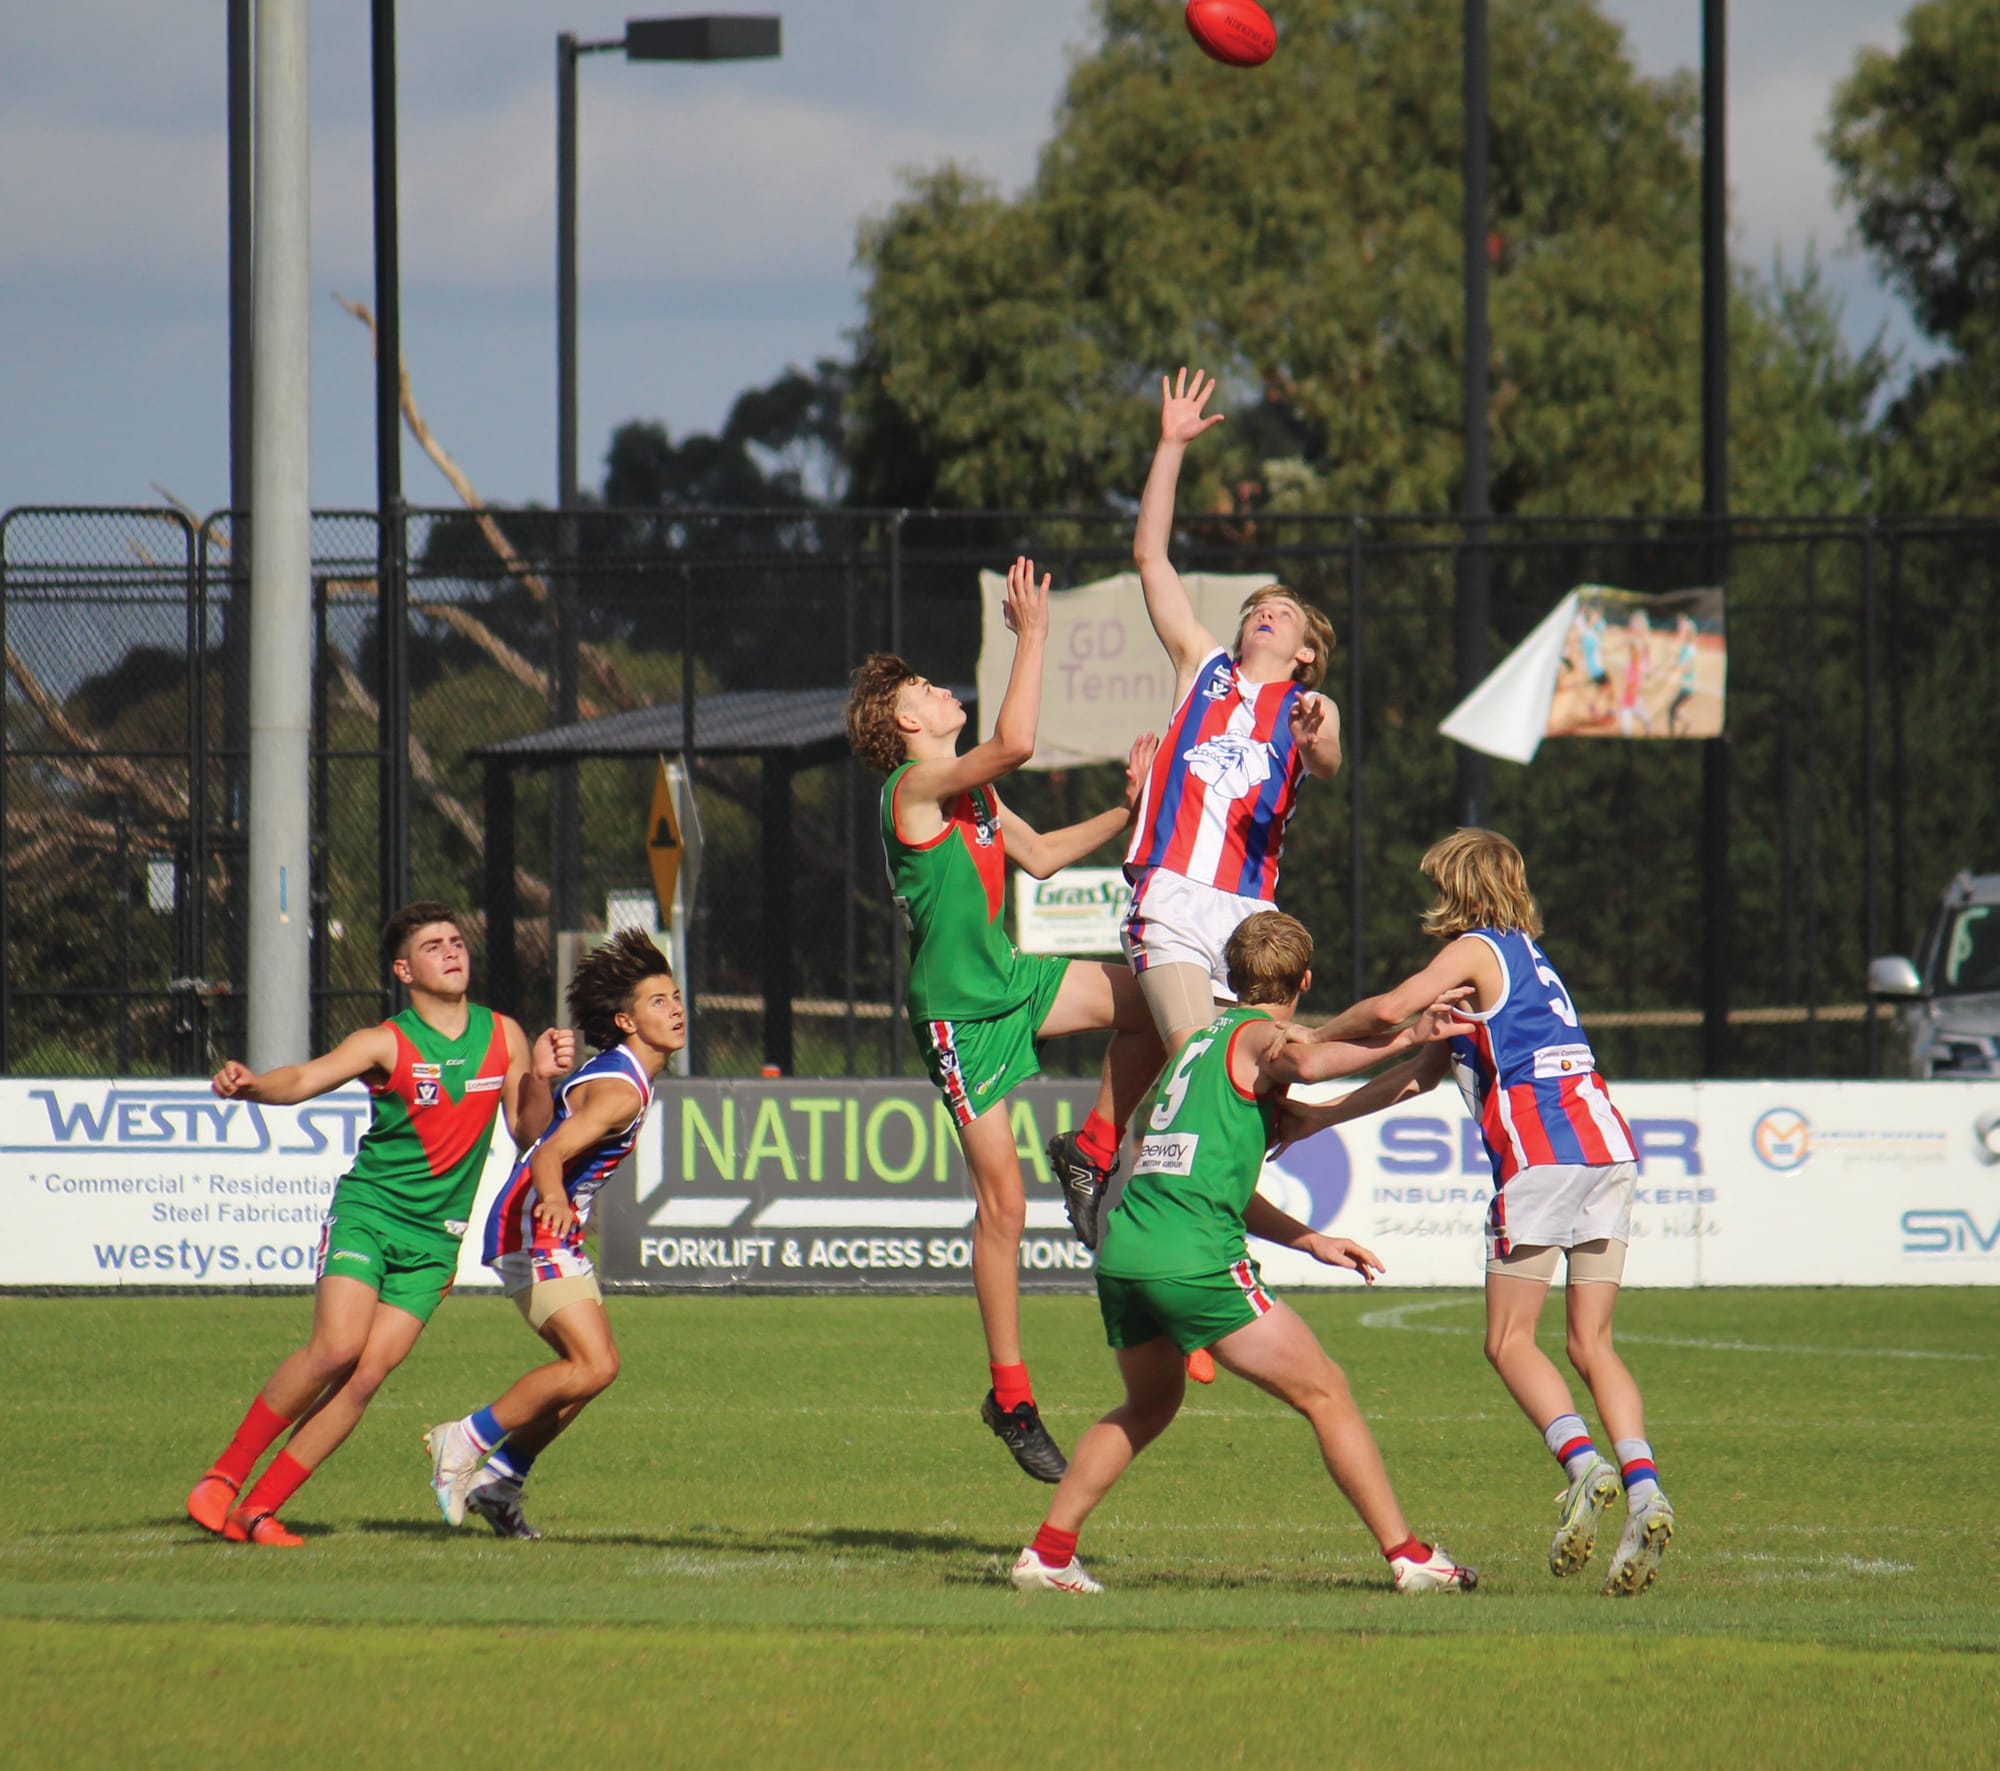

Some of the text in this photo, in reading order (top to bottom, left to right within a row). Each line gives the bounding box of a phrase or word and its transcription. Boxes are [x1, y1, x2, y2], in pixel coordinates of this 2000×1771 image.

[1068, 619, 1126, 660] GD
[1150, 1038, 1215, 1131] 5
[45, 1173, 184, 1194] Commercial
[1374, 1188, 1716, 1204] INSURA KERS
[152, 1203, 210, 1222] Steel
[640, 1238, 1095, 1270] FORKLIFT & ACCESS SOIONS
